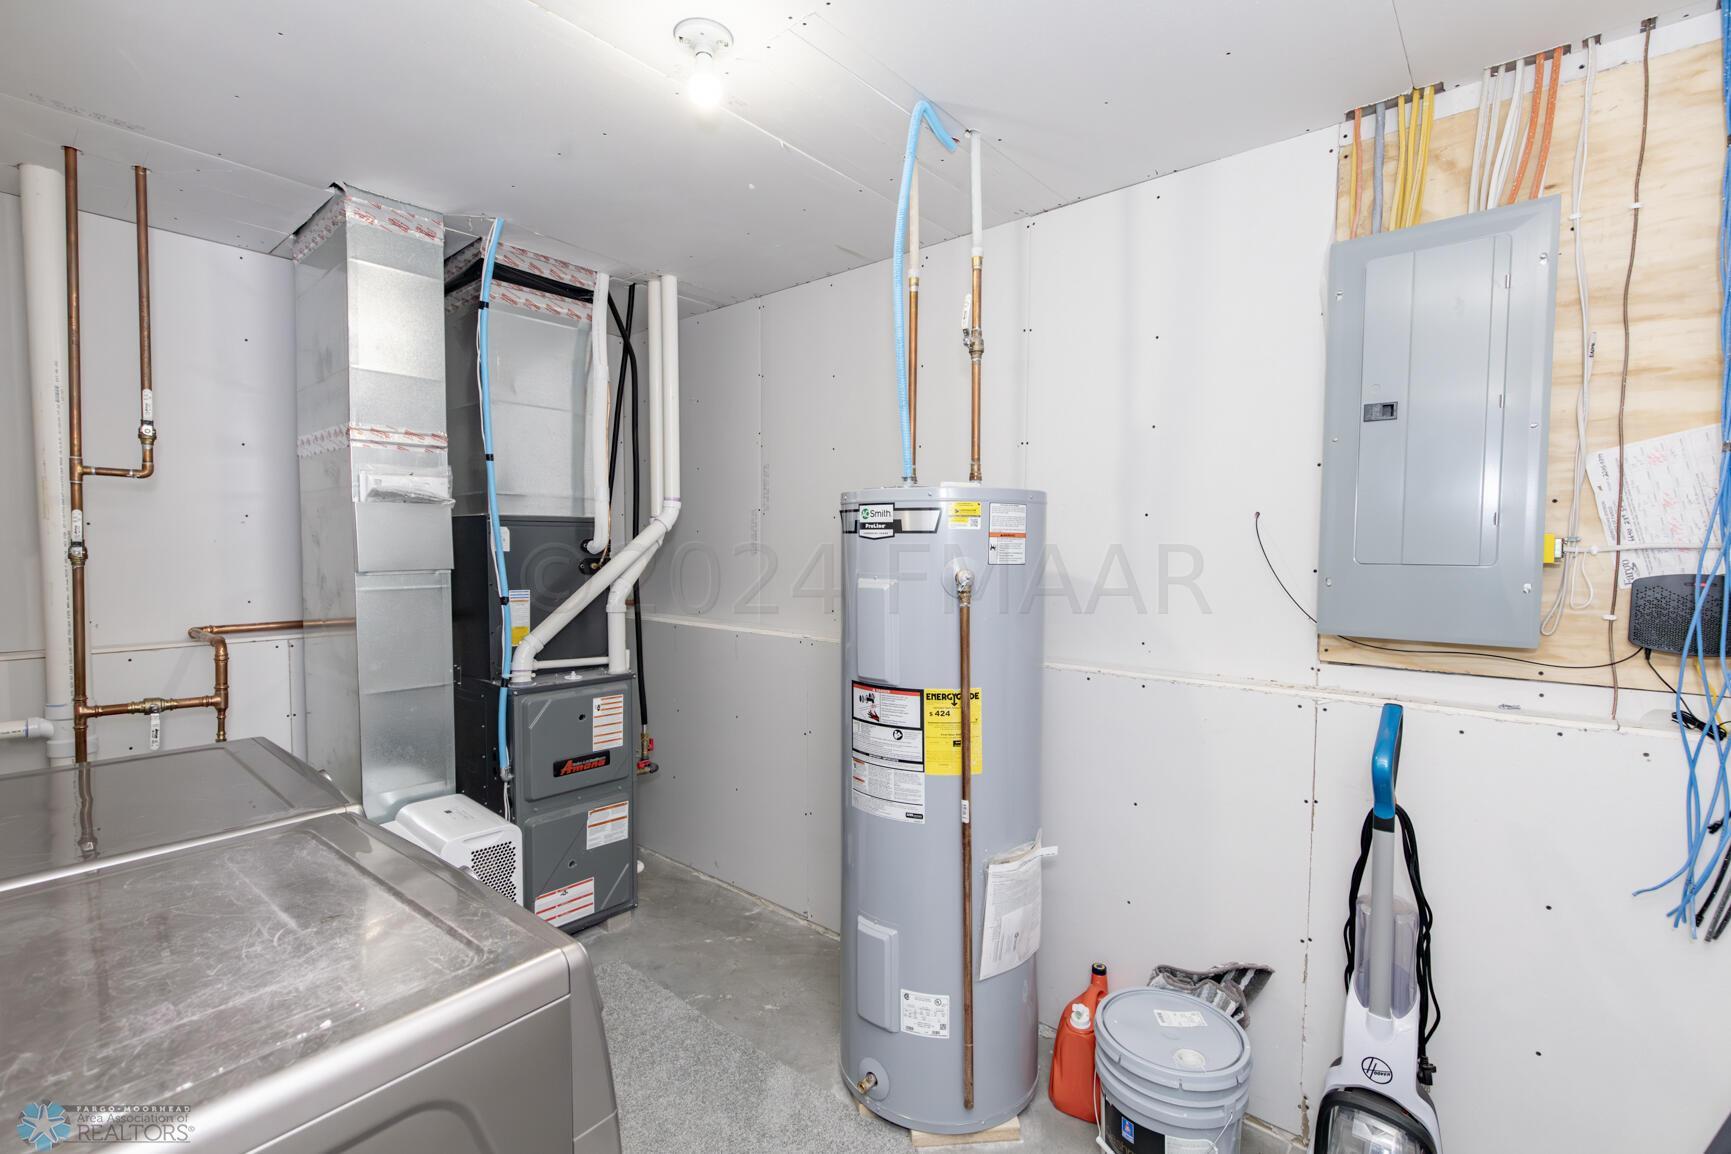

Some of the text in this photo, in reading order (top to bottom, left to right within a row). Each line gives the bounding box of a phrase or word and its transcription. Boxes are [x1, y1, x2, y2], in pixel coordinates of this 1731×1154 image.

[870, 509, 891, 518] Smith
[926, 692, 980, 701] ENERGYGDE
[560, 758, 607, 776] Amana
